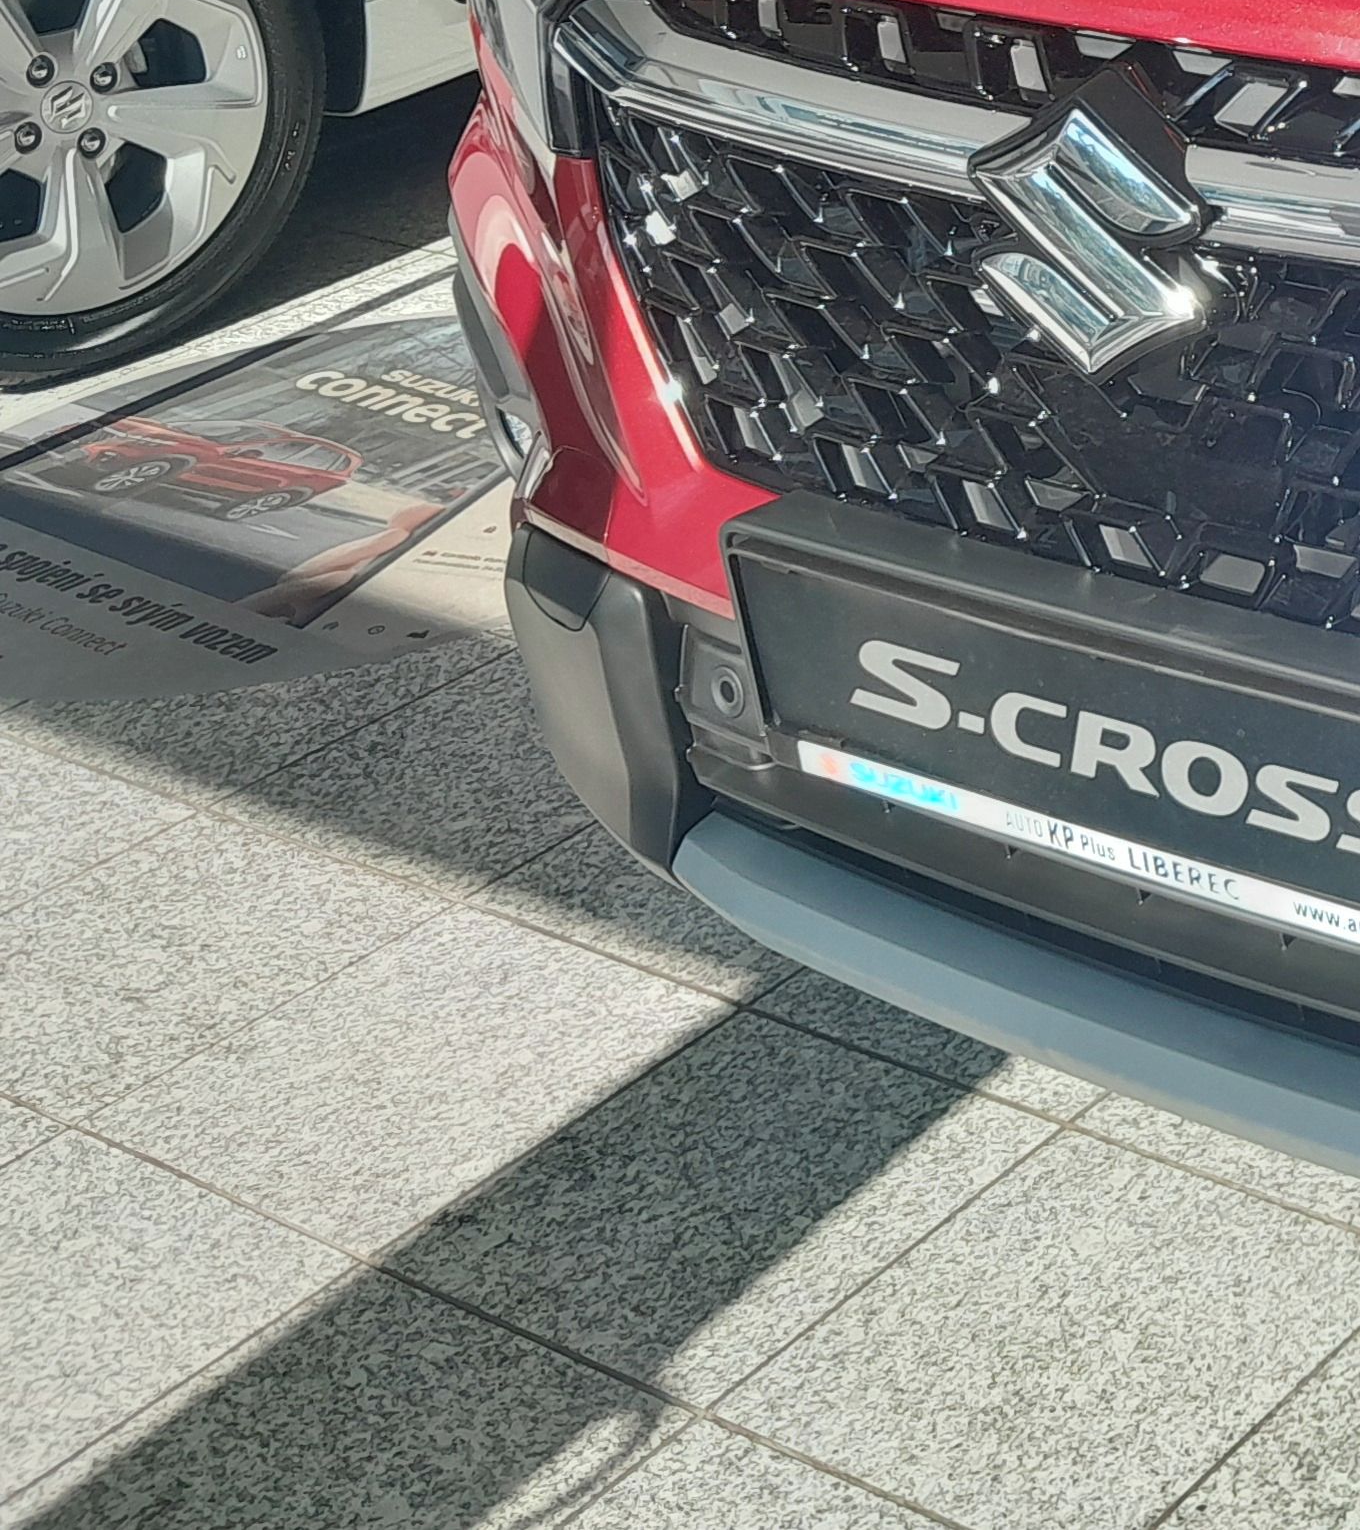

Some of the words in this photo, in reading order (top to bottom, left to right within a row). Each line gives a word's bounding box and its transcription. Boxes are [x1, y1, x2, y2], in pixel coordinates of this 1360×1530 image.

[381, 369, 479, 407] SUZUK
[39, 616, 128, 656] Connect
[76, 583, 124, 604] se
[109, 603, 195, 632] svým
[179, 622, 279, 664] vozem
[849, 761, 960, 812] SUZUKI
[1080, 833, 1117, 862] Plus
[1127, 846, 1241, 901] LIBEREC
